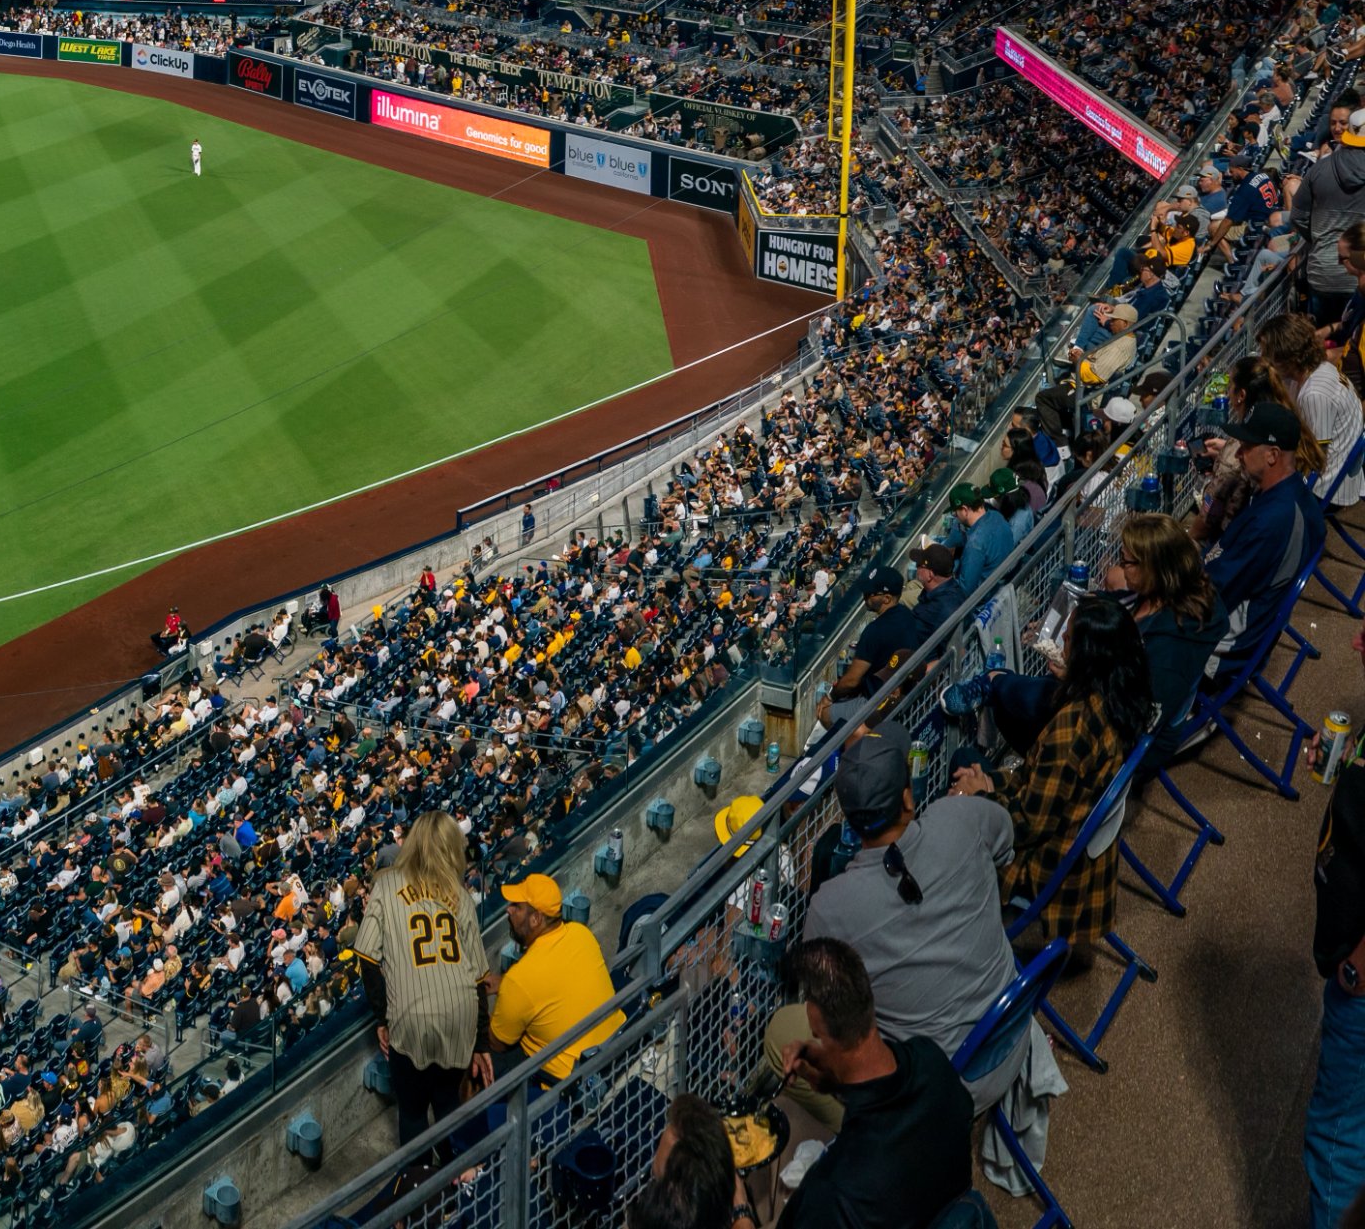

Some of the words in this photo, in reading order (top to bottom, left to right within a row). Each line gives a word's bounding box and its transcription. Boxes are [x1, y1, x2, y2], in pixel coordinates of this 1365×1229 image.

[0, 39, 15, 49] Diego
[17, 41, 35, 49] Health
[60, 42, 88, 53] WEST
[90, 45, 117, 55] LAKE
[371, 36, 433, 64] TEMPLETON
[150, 53, 189, 73] ClickUp
[238, 58, 272, 89] Bally
[449, 52, 464, 65] THE
[500, 63, 522, 77] DECK
[298, 78, 351, 104] EVOTEK
[377, 96, 439, 131] illumina
[684, 101, 713, 113] OFFICIAL
[745, 113, 757, 121] OF
[466, 126, 508, 146] Genomics
[510, 136, 522, 149] for
[524, 141, 547, 155] good
[569, 146, 594, 163] blue
[609, 155, 635, 172] blue
[1259, 181, 1278, 208] 51
[768, 234, 809, 258] HUNGRY
[813, 243, 834, 263] FOR
[764, 251, 838, 291] HOMERS
[296, 882, 302, 892] 9
[410, 910, 461, 968] 23
